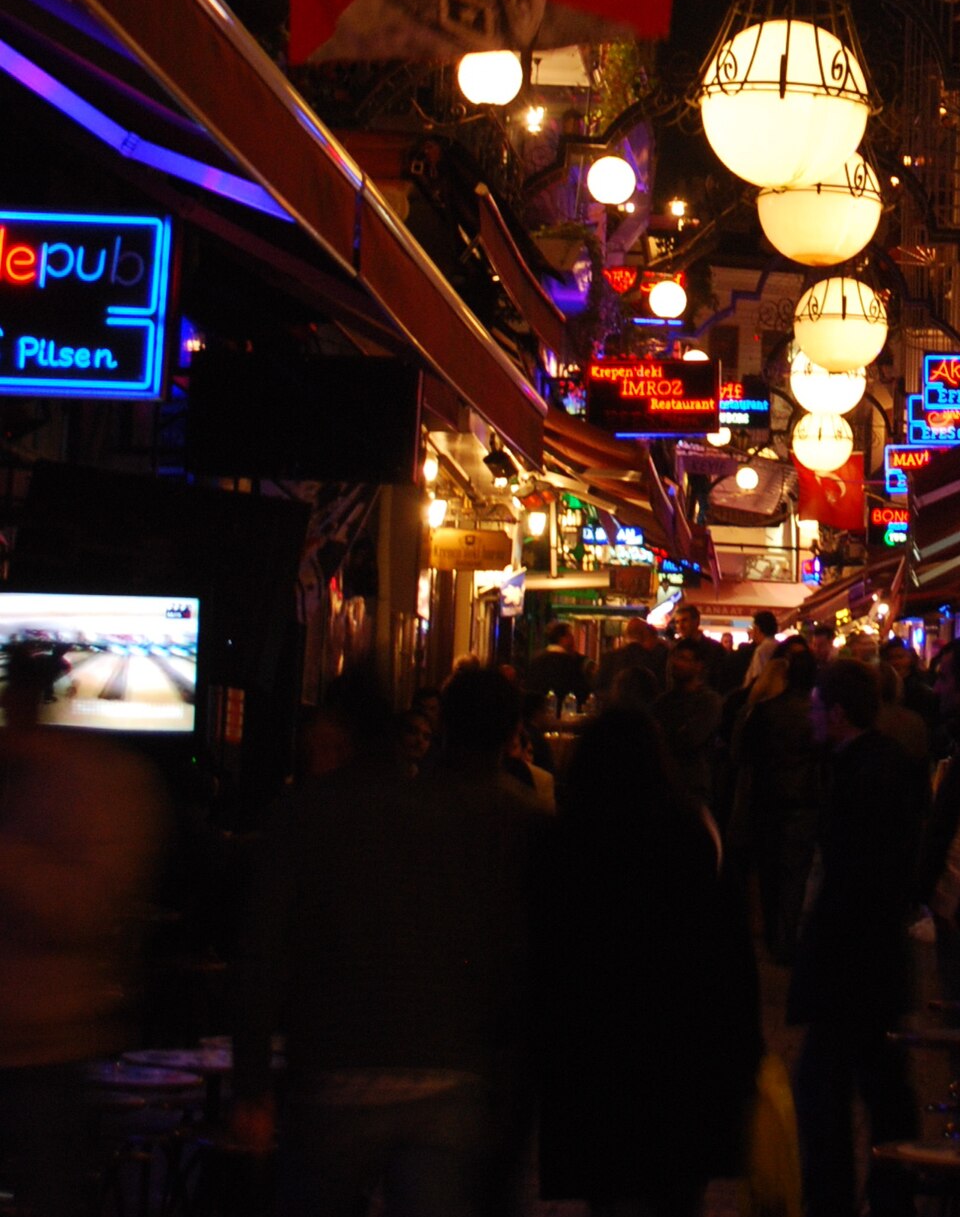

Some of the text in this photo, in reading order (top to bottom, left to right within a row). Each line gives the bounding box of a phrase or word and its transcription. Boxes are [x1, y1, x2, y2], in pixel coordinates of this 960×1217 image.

[18, 335, 118, 370] Pilsen
[591, 364, 663, 381] Krepen'deki
[650, 397, 716, 411] Restaurant
